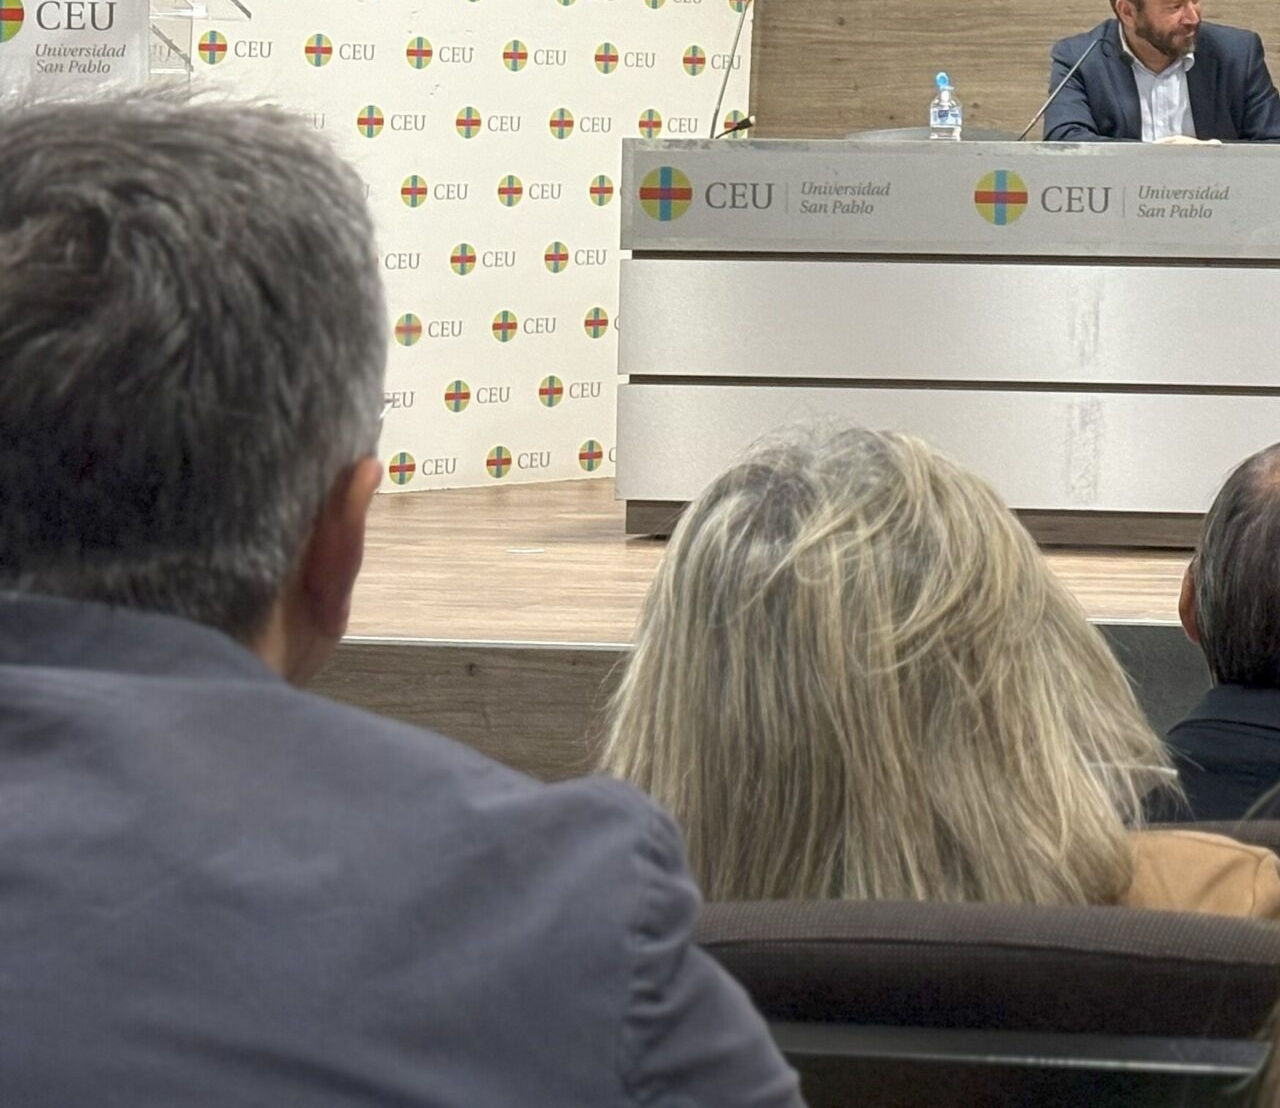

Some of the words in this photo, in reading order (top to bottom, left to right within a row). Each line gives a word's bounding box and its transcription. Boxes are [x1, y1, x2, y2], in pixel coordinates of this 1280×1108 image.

[37, 1, 117, 30] CEU
[36, 44, 126, 58] Universidad
[234, 40, 273, 58] CEU
[339, 43, 375, 61] CEU
[439, 46, 474, 63] CEU
[534, 49, 567, 66] CEU
[37, 60, 64, 72] San
[69, 60, 110, 73] Pablo
[624, 52, 656, 68] CEU
[391, 114, 426, 131] CEU
[487, 115, 521, 132] CEU
[580, 117, 612, 133] CEU
[667, 117, 699, 133] CEU
[434, 184, 468, 200] CEU
[529, 183, 562, 200] CEU
[705, 182, 775, 209] CEU
[801, 182, 891, 196] Universidad
[1138, 184, 1230, 200] Universidad
[800, 200, 828, 214] San
[832, 200, 874, 214] Pablo
[1041, 186, 1112, 213] CEU
[1137, 204, 1165, 218] San
[1169, 204, 1212, 218] Pablo
[385, 253, 421, 270] CEU
[482, 251, 516, 268] CEU
[574, 249, 608, 266] CEU
[428, 320, 462, 338] CEU
[523, 317, 556, 334] CEU
[476, 386, 511, 404] CEU
[569, 382, 603, 399] CEU
[422, 457, 457, 476] CEU
[517, 452, 551, 469] CEU
